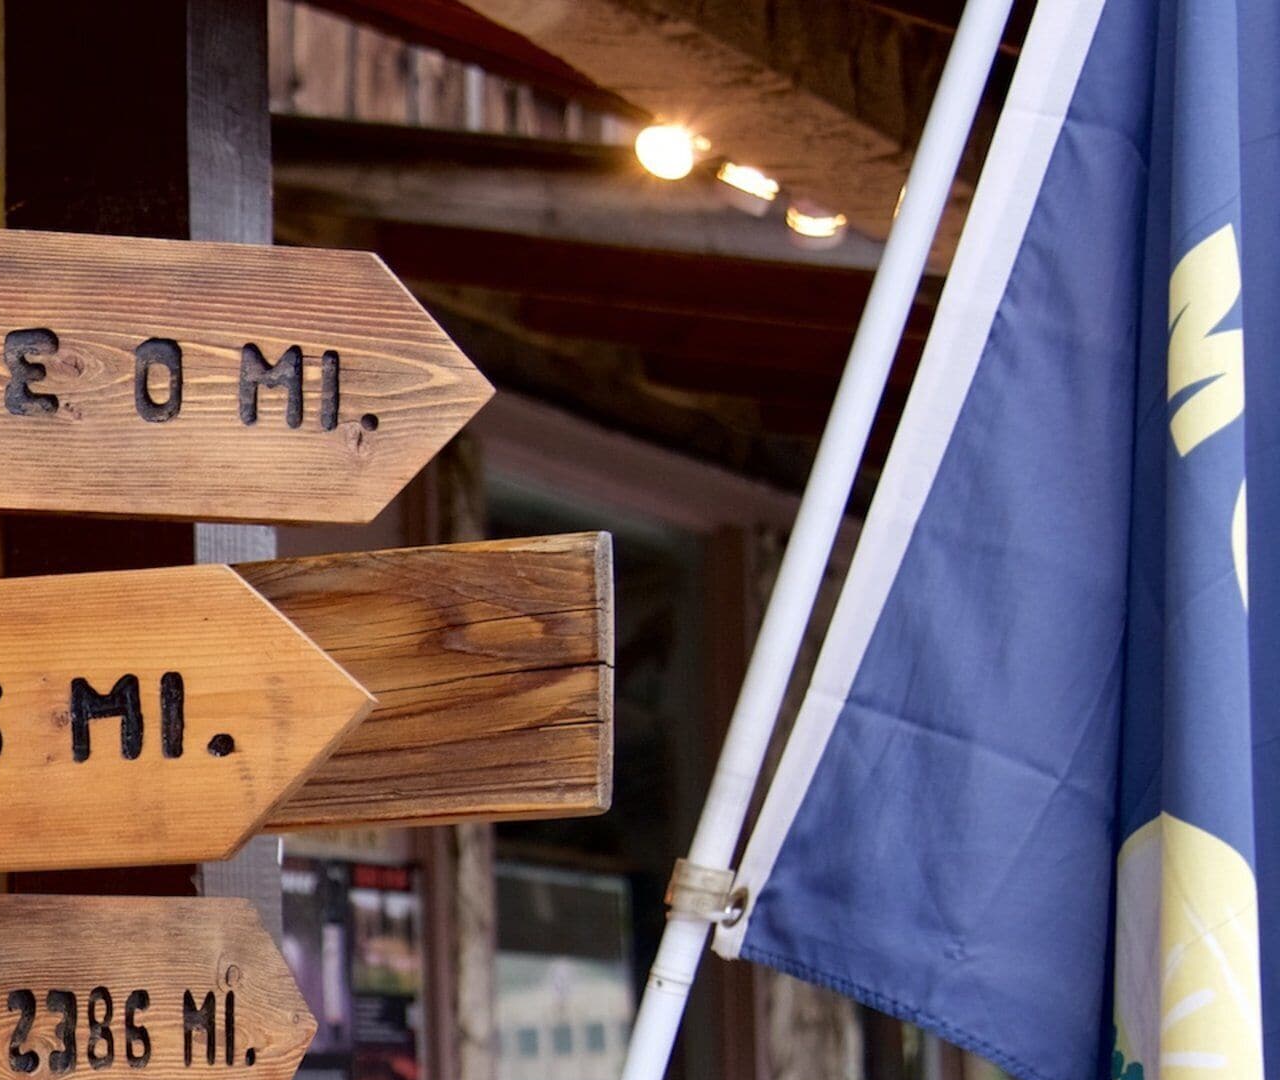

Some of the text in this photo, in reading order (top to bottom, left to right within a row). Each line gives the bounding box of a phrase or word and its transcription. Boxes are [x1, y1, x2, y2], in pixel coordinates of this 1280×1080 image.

[240, 342, 379, 431] MI.
[71, 671, 236, 763] MI.
[7, 985, 153, 1074] 2386
[183, 989, 256, 1068] MI.
